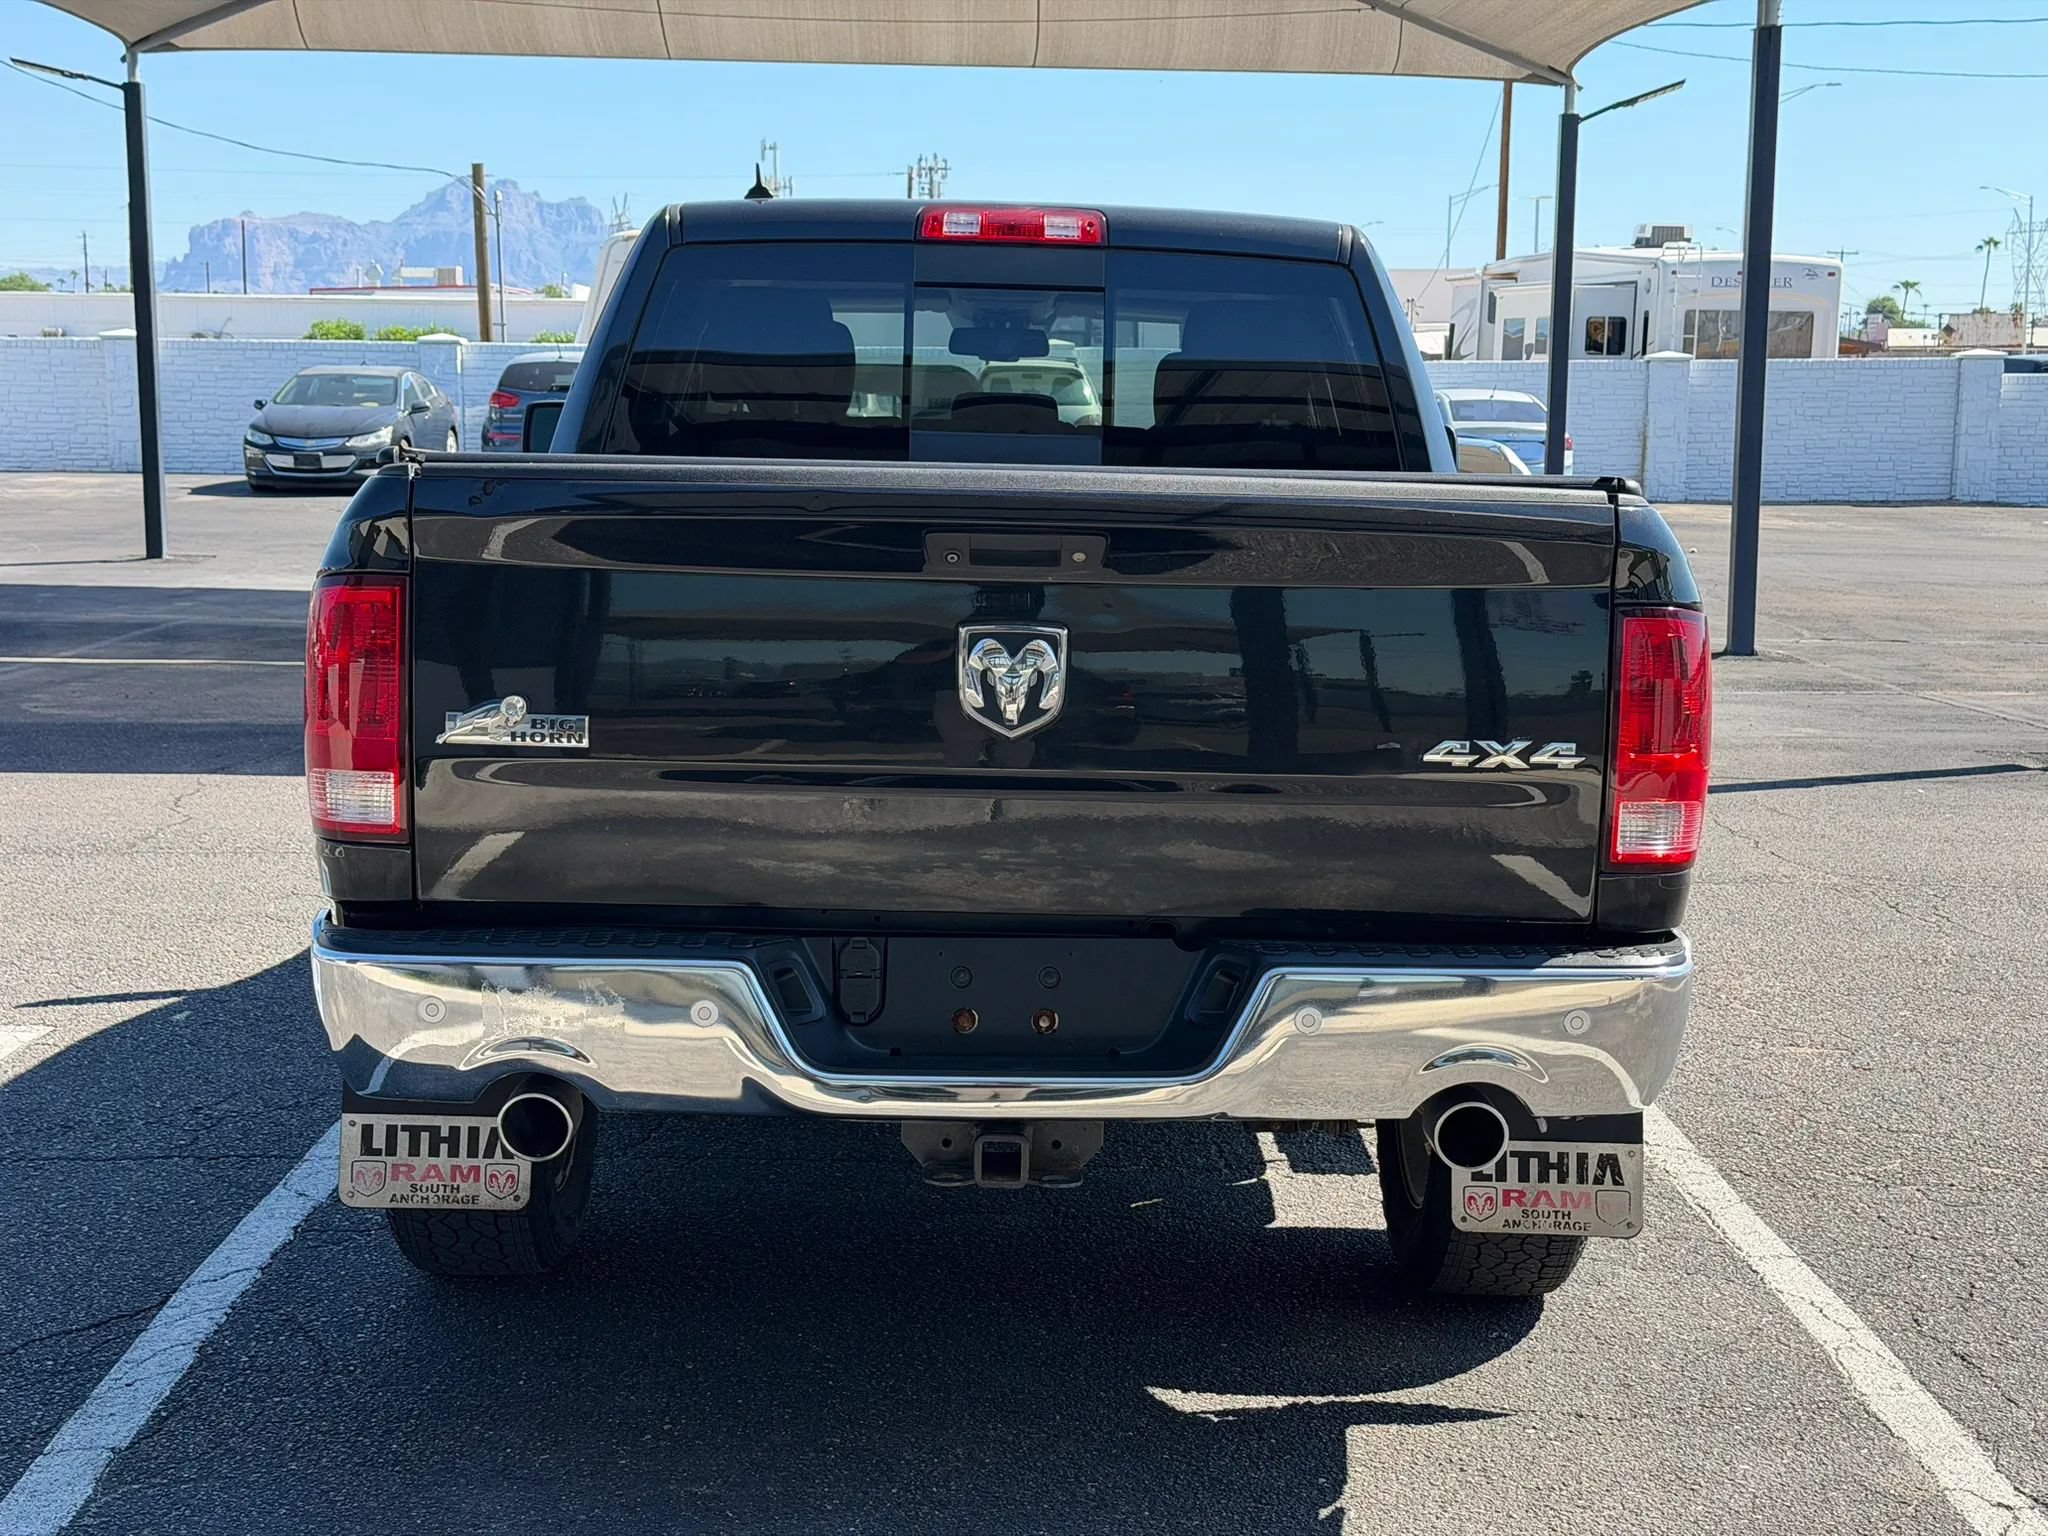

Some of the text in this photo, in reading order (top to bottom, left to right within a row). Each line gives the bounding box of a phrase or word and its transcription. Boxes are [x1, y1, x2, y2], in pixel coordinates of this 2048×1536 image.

[1710, 276, 1793, 288] DESER
[530, 718, 576, 731] BIG
[510, 731, 584, 744] HORN
[1422, 739, 1587, 770] 4X4
[390, 1163, 481, 1184] RAM
[409, 1183, 461, 1194] SOUTH
[389, 1194, 481, 1206] ANCHORAGE
[1502, 1188, 1593, 1210] RAM
[1520, 1208, 1572, 1221] SOUTH
